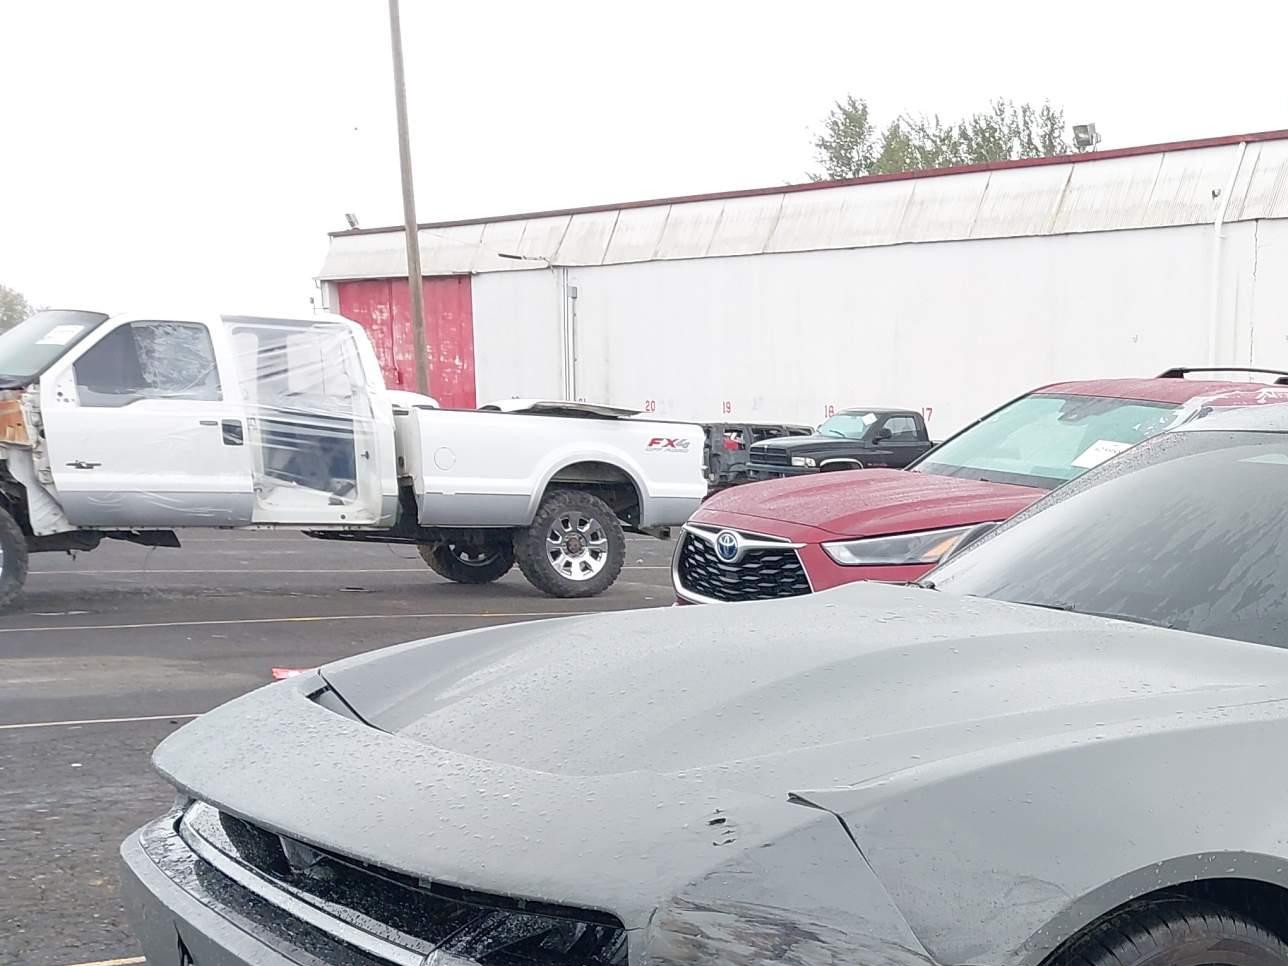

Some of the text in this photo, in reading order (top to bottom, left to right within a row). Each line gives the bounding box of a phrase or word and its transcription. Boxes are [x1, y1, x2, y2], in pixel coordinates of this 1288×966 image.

[645, 399, 656, 412] 20
[722, 400, 732, 414] 19
[824, 404, 835, 418] 18
[648, 437, 690, 449] FX4
